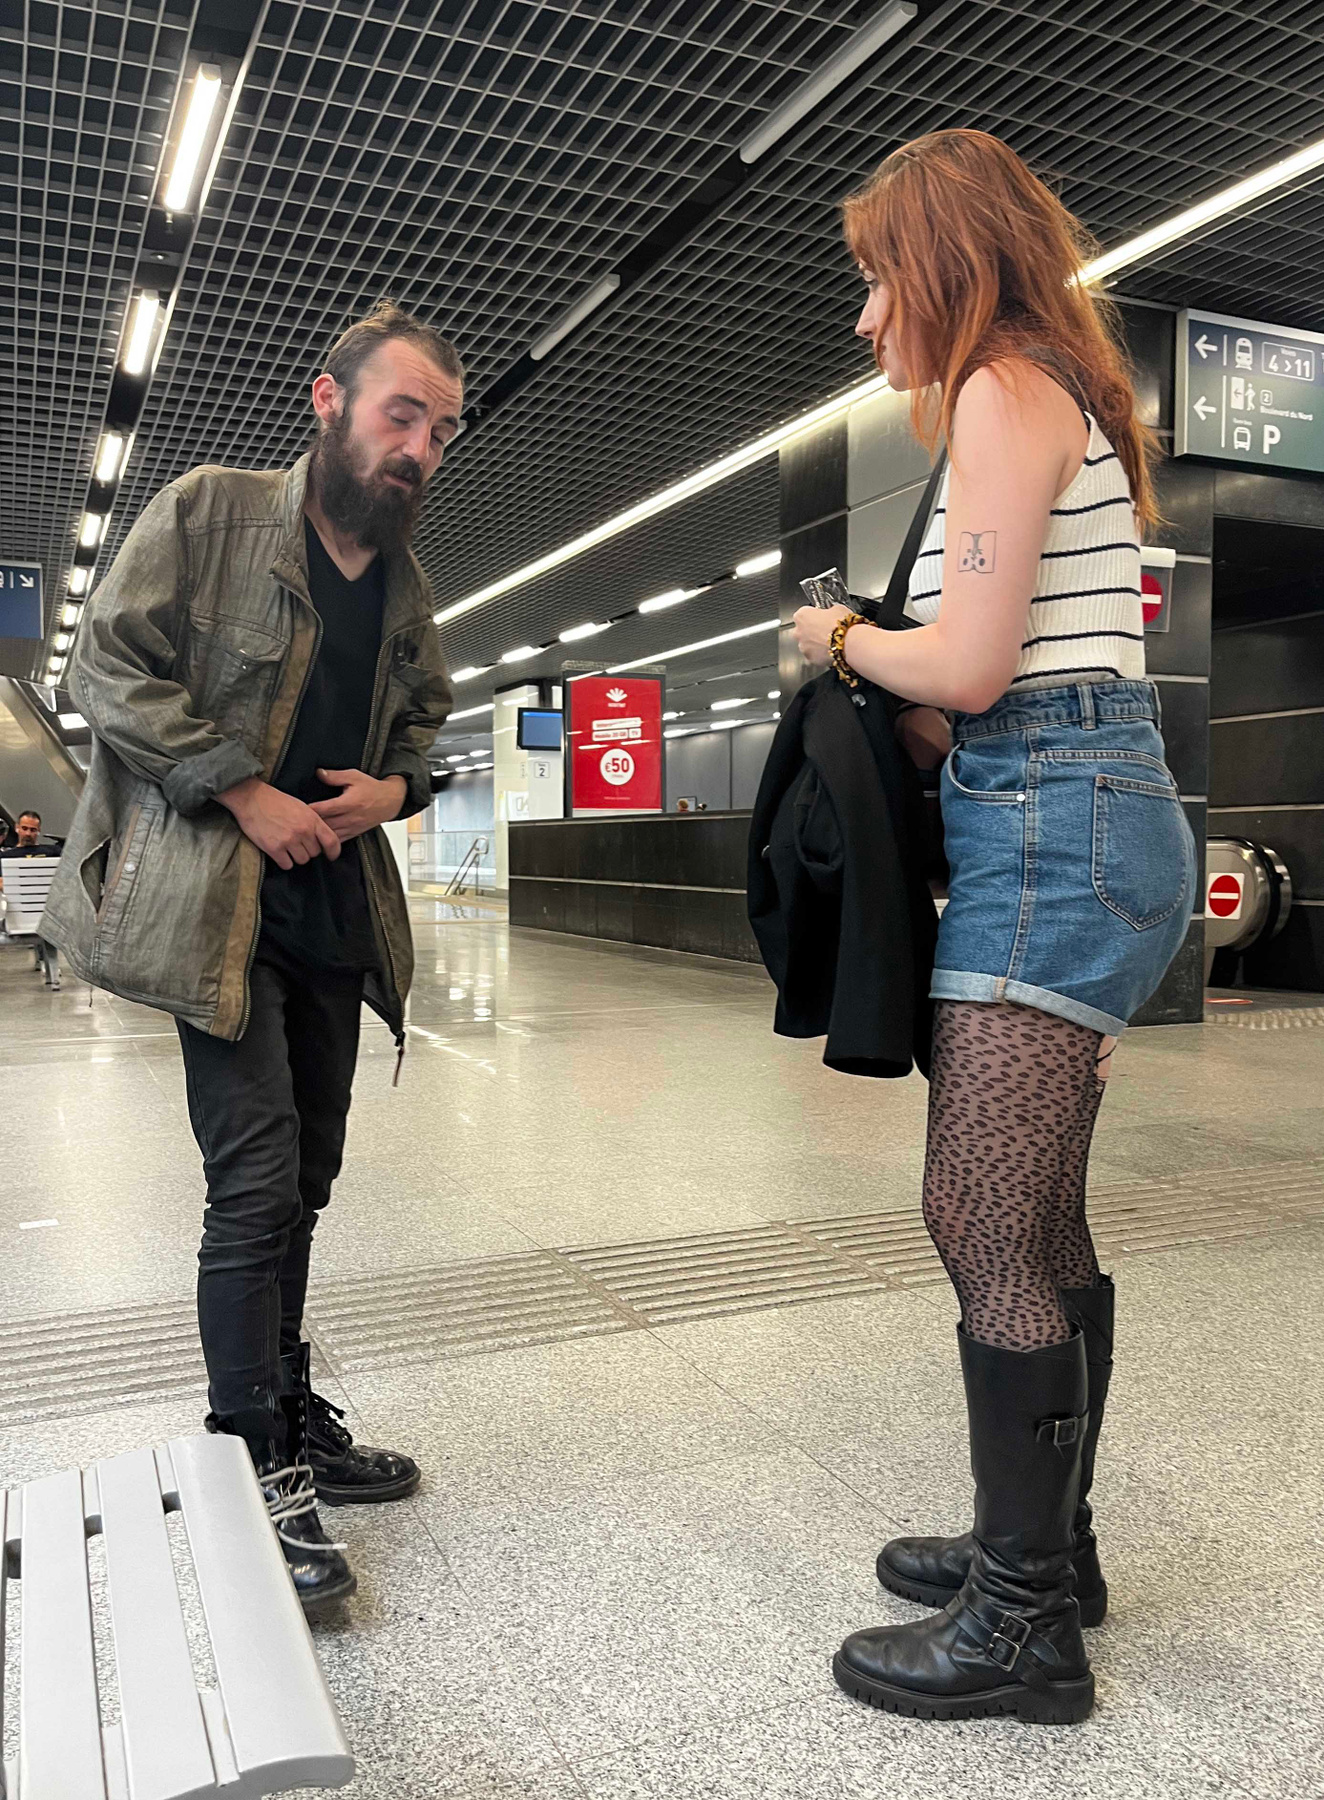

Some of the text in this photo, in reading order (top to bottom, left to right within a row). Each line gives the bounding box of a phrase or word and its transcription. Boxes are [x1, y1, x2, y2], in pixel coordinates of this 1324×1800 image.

[1268, 354, 1279, 372] 4
[1294, 358, 1310, 378] 11
[1263, 393, 1269, 403] 2
[1263, 424, 1281, 454] P
[539, 767, 545, 777] 2
[605, 757, 630, 774] €50
